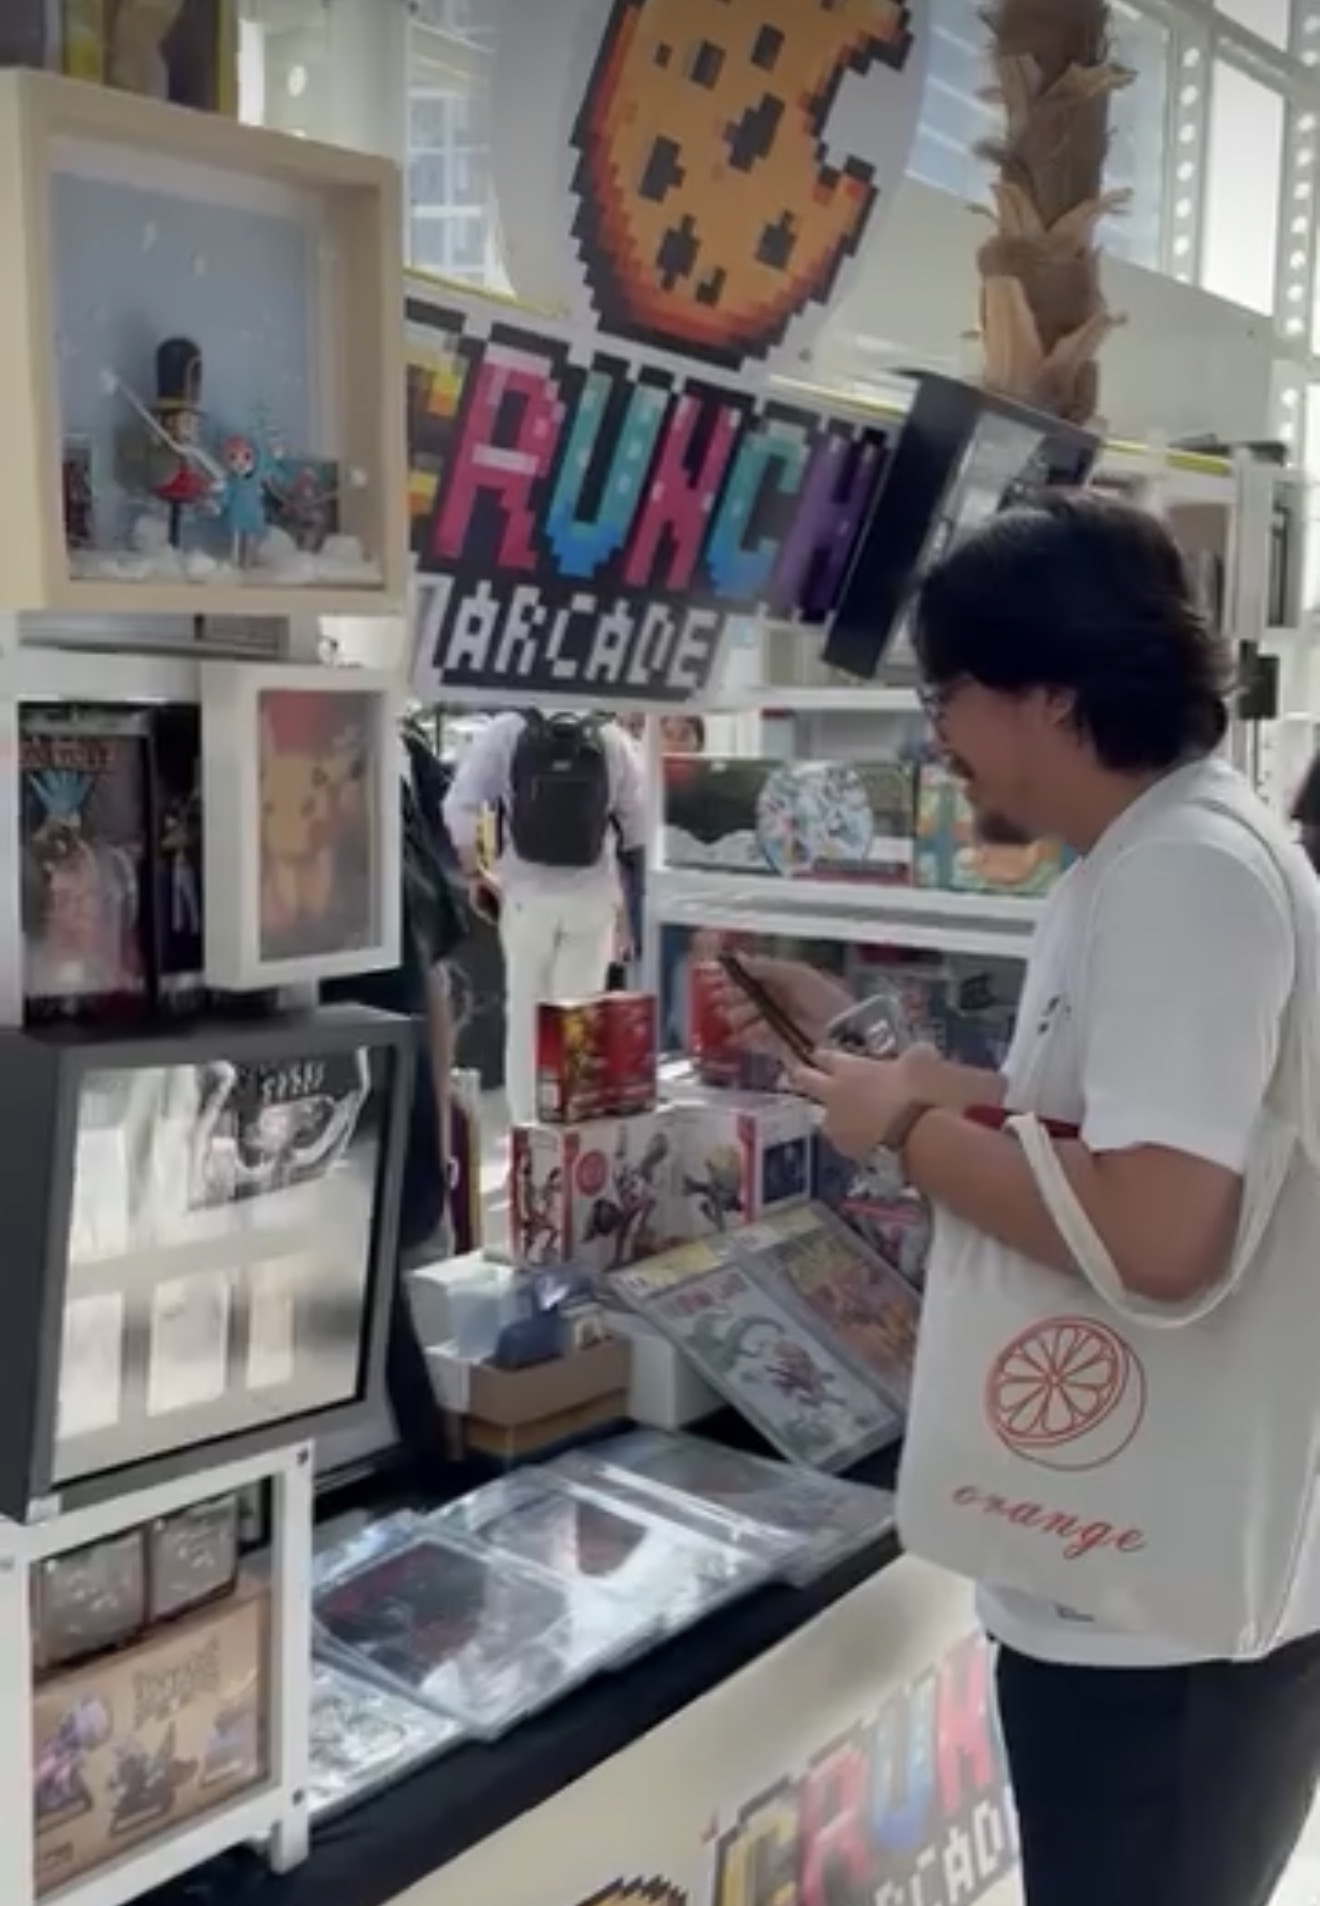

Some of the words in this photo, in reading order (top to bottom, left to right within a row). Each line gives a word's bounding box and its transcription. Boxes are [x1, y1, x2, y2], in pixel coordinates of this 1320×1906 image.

[445, 581, 718, 687] ARCADE
[952, 1485, 1146, 1560] orange
[722, 1637, 1007, 1906] CRUN
